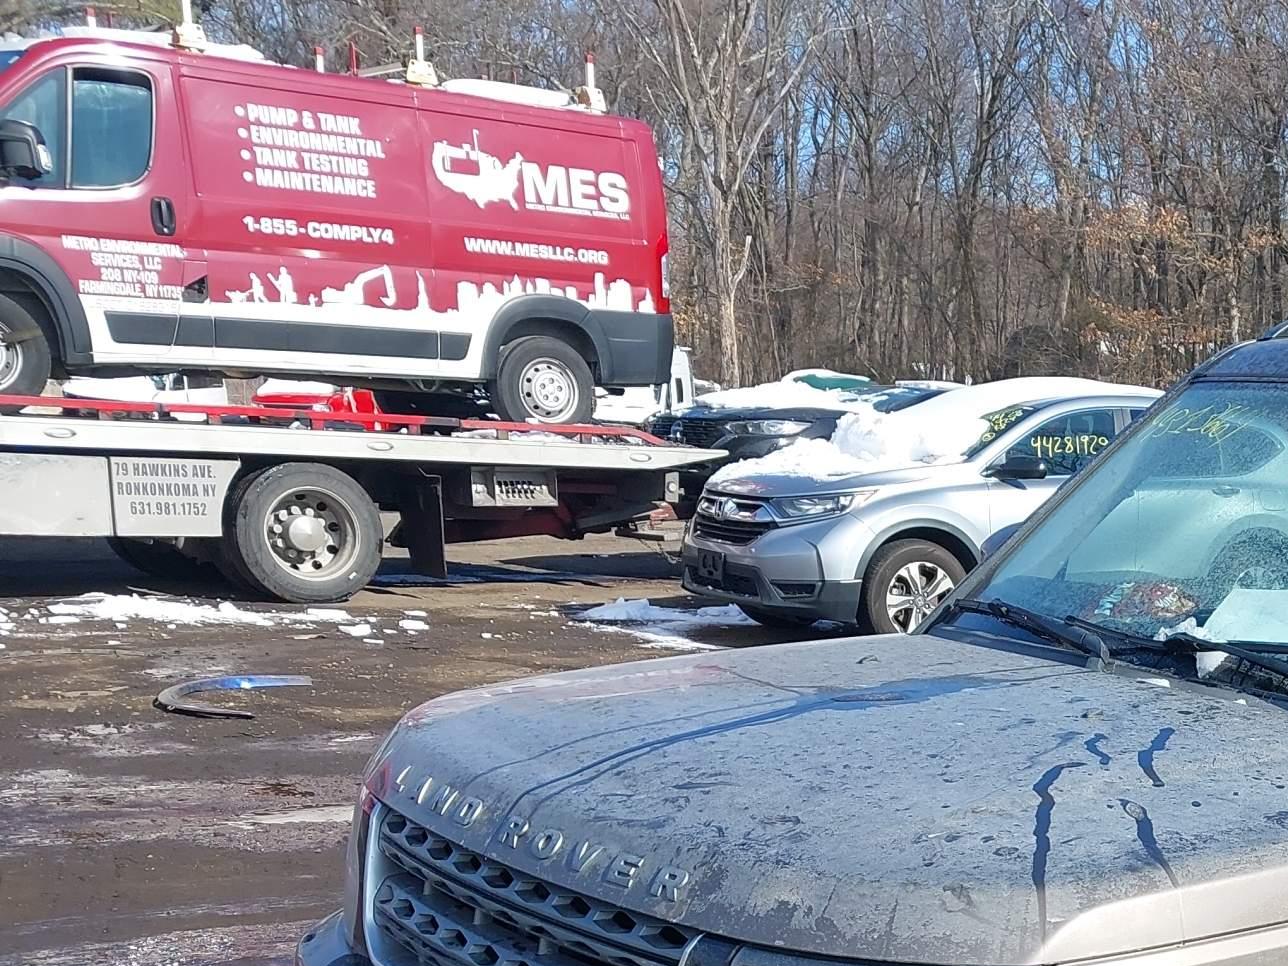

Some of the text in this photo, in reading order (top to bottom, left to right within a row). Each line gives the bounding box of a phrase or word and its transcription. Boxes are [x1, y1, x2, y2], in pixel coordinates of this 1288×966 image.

[247, 103, 362, 135] PUMP & TANK
[250, 124, 386, 159] ENVIRONMENTAL
[253, 146, 369, 177] TANK TESTING
[255, 167, 377, 199] MAINTENANCE
[520, 162, 630, 213] MES
[61, 234, 99, 251] METRO
[464, 236, 609, 266] WWW.MESLLC.ORG
[101, 267, 121, 282] 208
[143, 255, 162, 271] LLC
[145, 283, 159, 298] NY
[1031, 434, 1109, 458] 44281920
[114, 462, 217, 479] 79 HAWKINS AVE.
[117, 481, 217, 497] RONKONKOMA NY
[130, 501, 208, 516] 631.981.1752
[501, 814, 691, 903] ROVER
